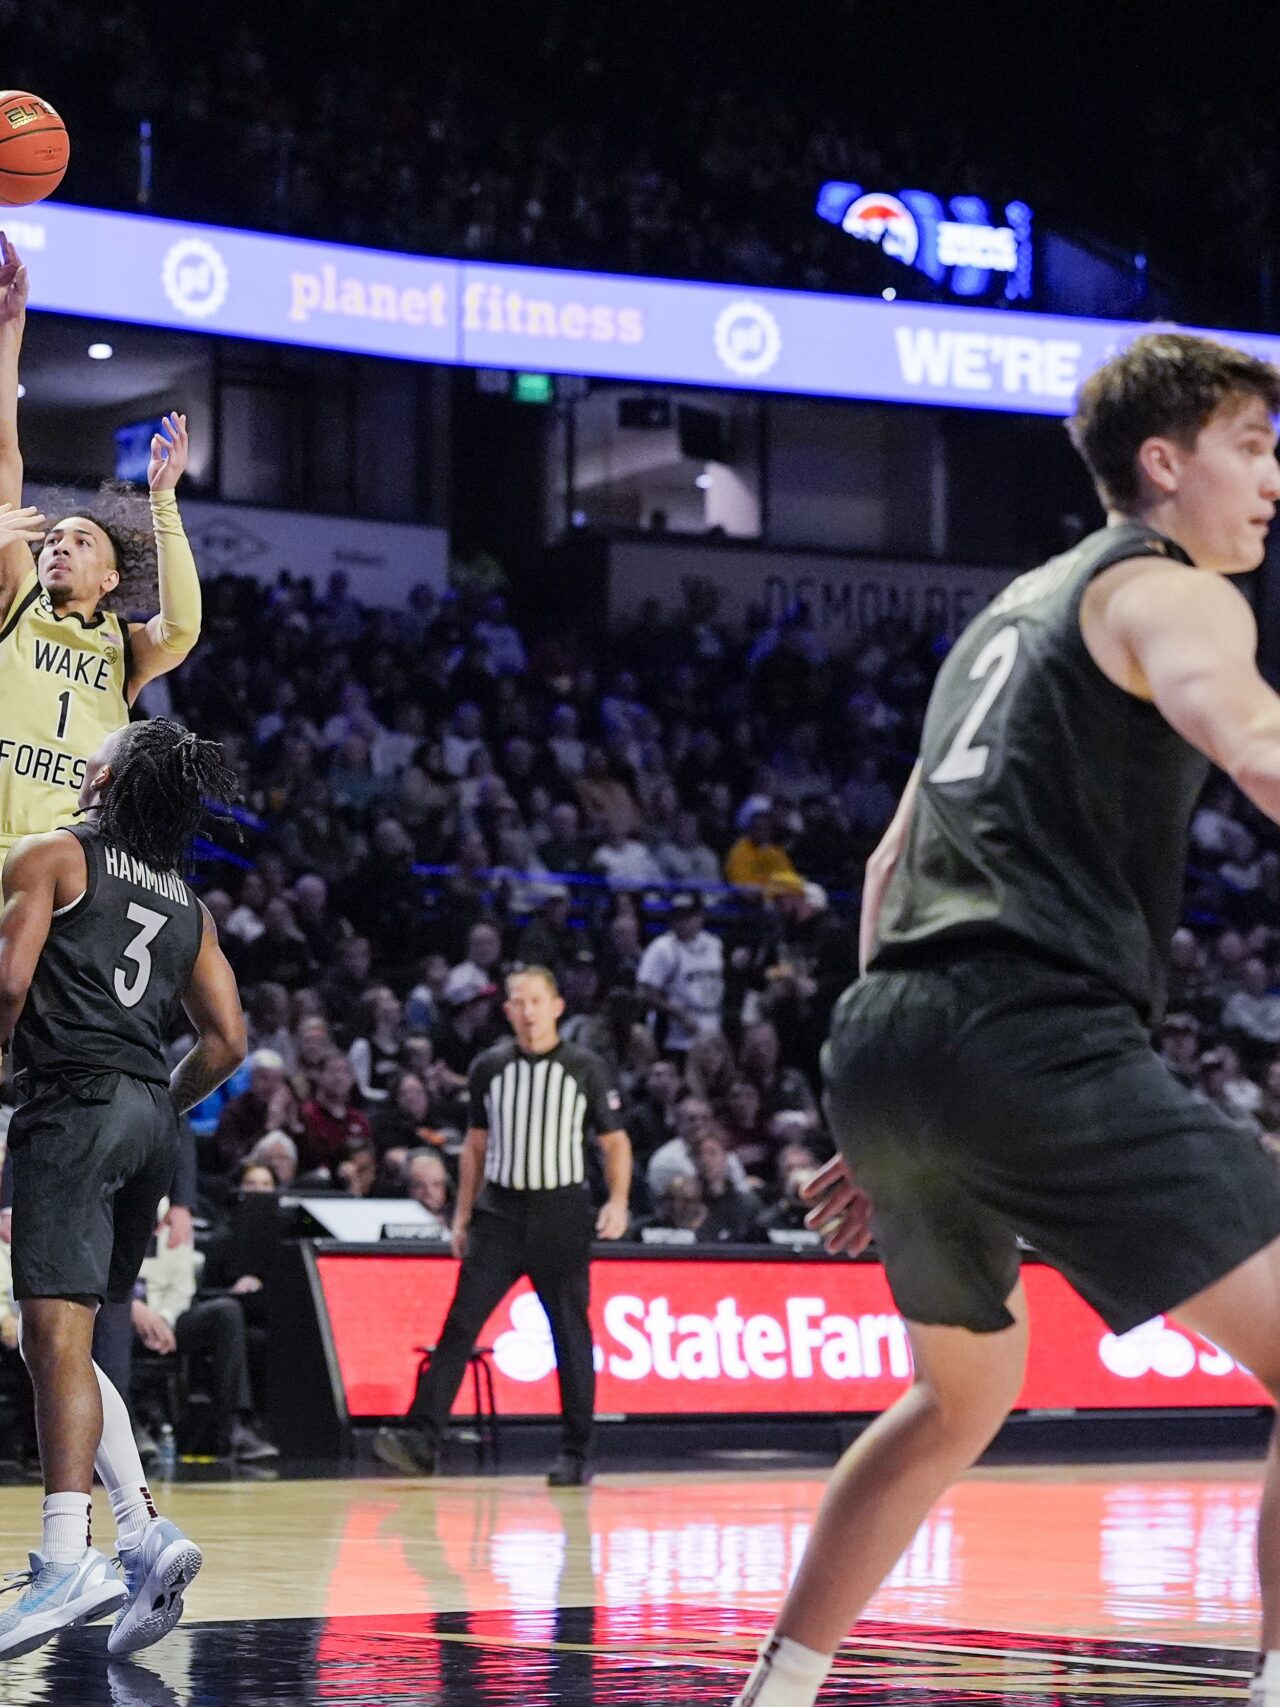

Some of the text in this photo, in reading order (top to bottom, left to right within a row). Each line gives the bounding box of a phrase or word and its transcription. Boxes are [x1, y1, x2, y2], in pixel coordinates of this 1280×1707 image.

[288, 263, 644, 344] planet fitness
[895, 326, 1083, 398] WE'RE
[34, 639, 109, 691] WAKE
[56, 691, 70, 738] 1
[930, 625, 1018, 783] 2
[113, 901, 168, 1008] 3
